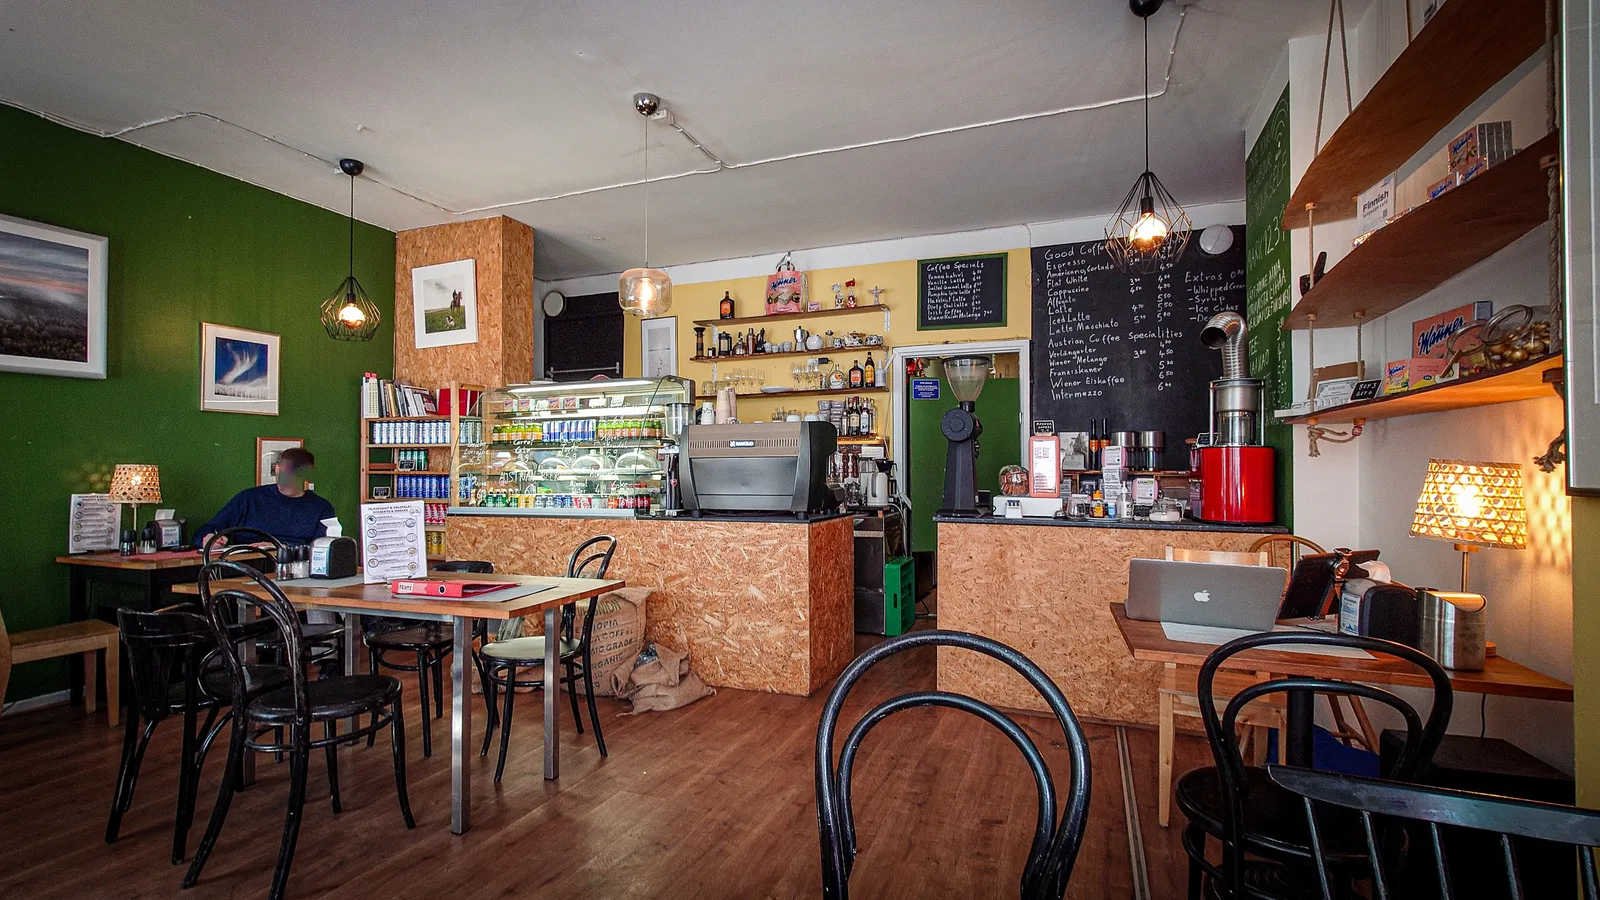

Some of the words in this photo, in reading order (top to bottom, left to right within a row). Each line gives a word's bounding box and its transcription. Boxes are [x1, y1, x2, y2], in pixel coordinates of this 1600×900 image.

[1363, 190, 1389, 212] Finnish
[1044, 246, 1074, 260] Good
[927, 264, 950, 272] Coffee
[954, 261, 984, 271] Specials
[1046, 259, 1086, 271] Espresso
[1087, 262, 1114, 272] Cortado
[1047, 279, 1061, 288] Flat
[1066, 276, 1088, 284] White
[1185, 271, 1222, 283] Extras
[1048, 286, 1089, 300] Cappuccino
[1049, 306, 1072, 315] Latte
[1050, 315, 1065, 326] Iced
[1068, 312, 1090, 322] Latte
[1049, 325, 1073, 336] Latte
[1077, 318, 1118, 331] Macchiato
[1048, 337, 1084, 348] Austrian
[1089, 334, 1120, 344] Coffee
[1128, 326, 1183, 342] Specialities
[1418, 315, 1465, 356] Manner
[1077, 356, 1108, 366] Melange
[1050, 365, 1102, 377] Franziskaner
[1050, 377, 1081, 388] Wiener
[1086, 376, 1125, 386] Eiskaffee
[1051, 389, 1102, 400] Intermezzo
